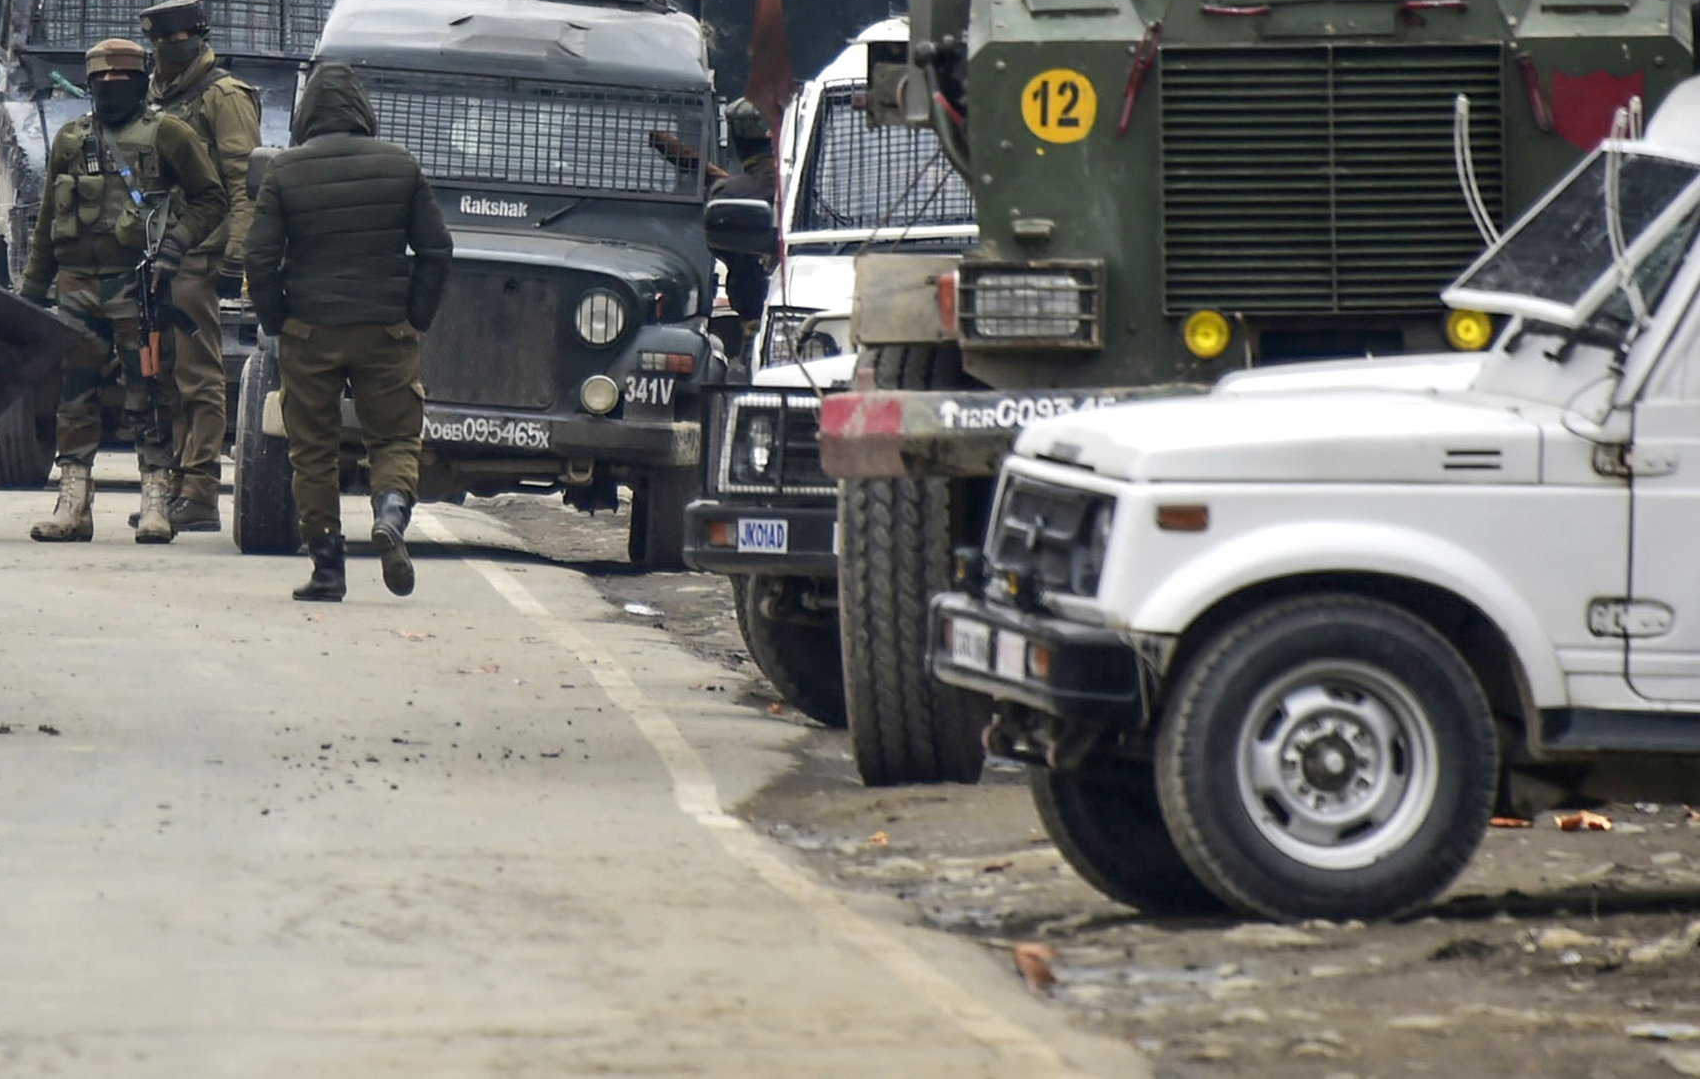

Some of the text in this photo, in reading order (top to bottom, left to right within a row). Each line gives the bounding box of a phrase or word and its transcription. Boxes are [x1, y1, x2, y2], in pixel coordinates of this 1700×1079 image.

[1032, 80, 1080, 127] 12
[460, 195, 529, 218] Rakshak
[624, 376, 675, 406] 341V
[741, 522, 786, 549] JK01AD
